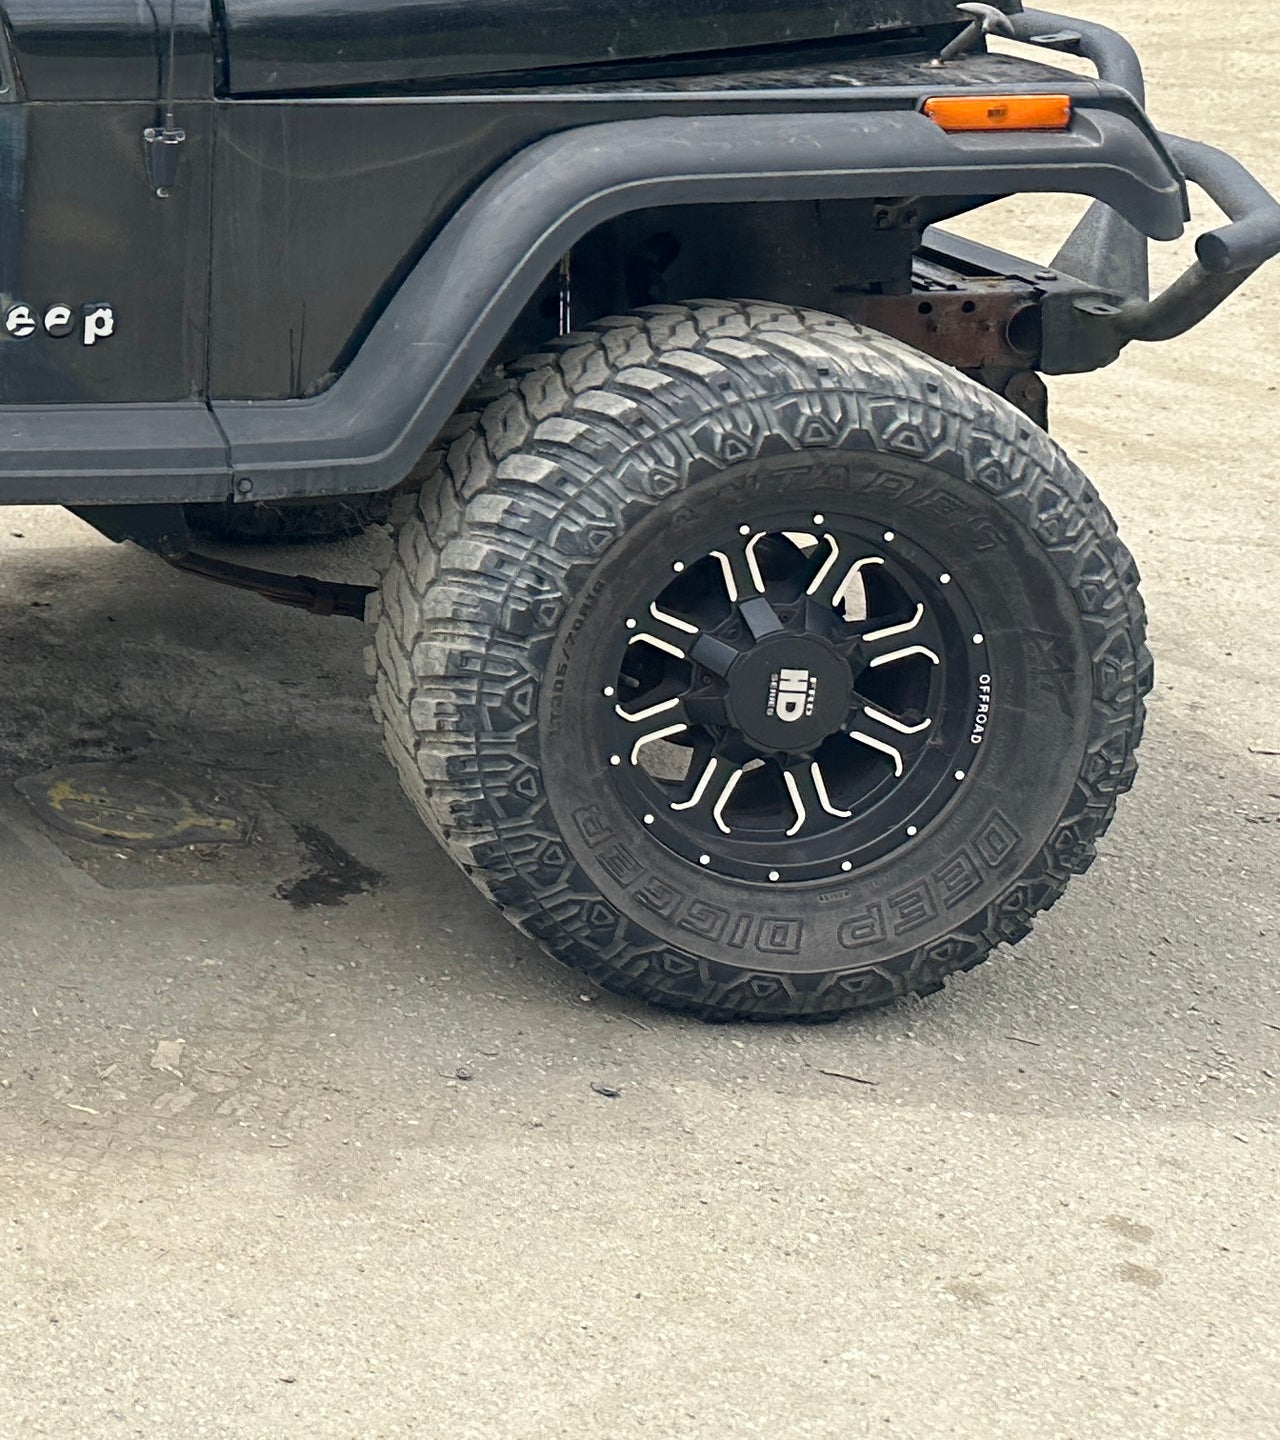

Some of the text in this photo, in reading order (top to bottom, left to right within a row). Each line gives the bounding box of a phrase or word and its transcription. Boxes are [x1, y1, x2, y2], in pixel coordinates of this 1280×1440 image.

[776, 668, 809, 722] HD
[970, 673, 991, 744] OFFROAD
[571, 805, 1024, 955] DEEP DIGGER
